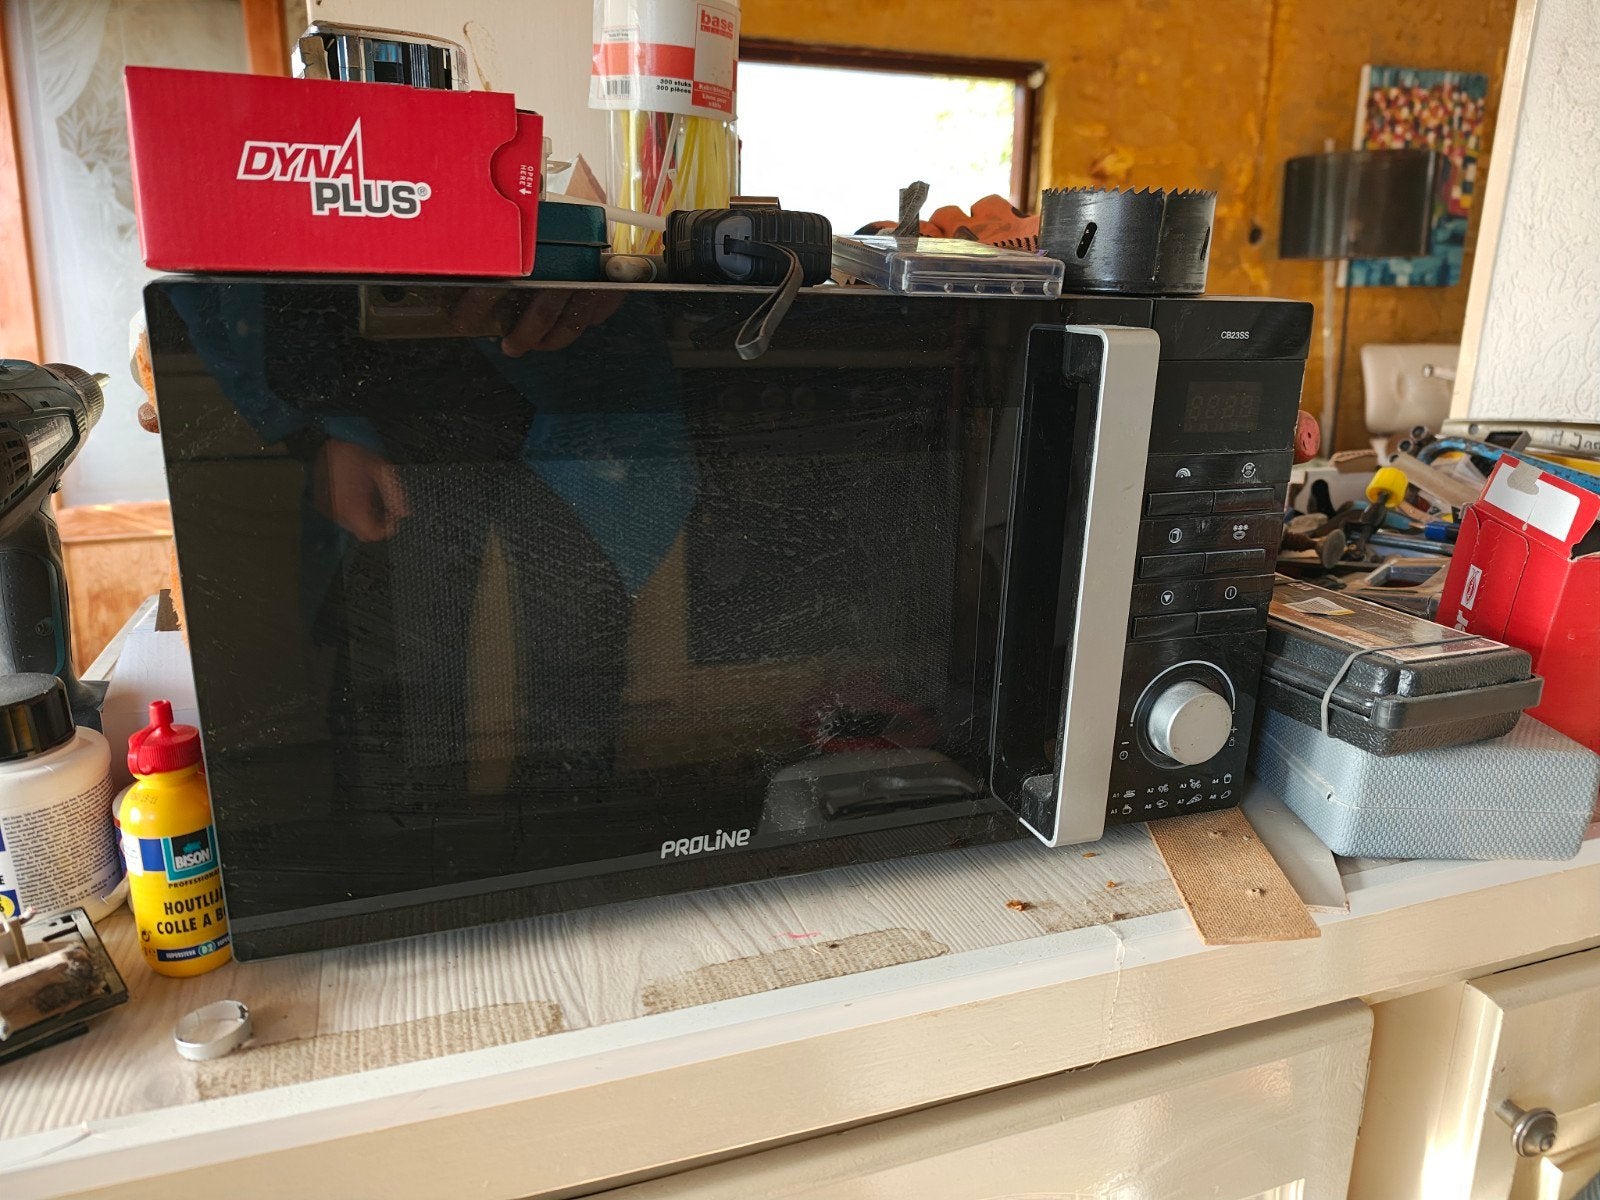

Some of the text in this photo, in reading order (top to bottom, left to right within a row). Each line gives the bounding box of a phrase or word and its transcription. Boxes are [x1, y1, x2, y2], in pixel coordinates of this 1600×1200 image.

[701, 9, 733, 32] base
[237, 117, 365, 190] DYNA
[526, 166, 534, 188] OPEN
[1221, 331, 1250, 340] CB23SS
[174, 847, 210, 870] BISON
[168, 867, 220, 889] PROFESSIONA
[156, 917, 197, 935] COLLE
